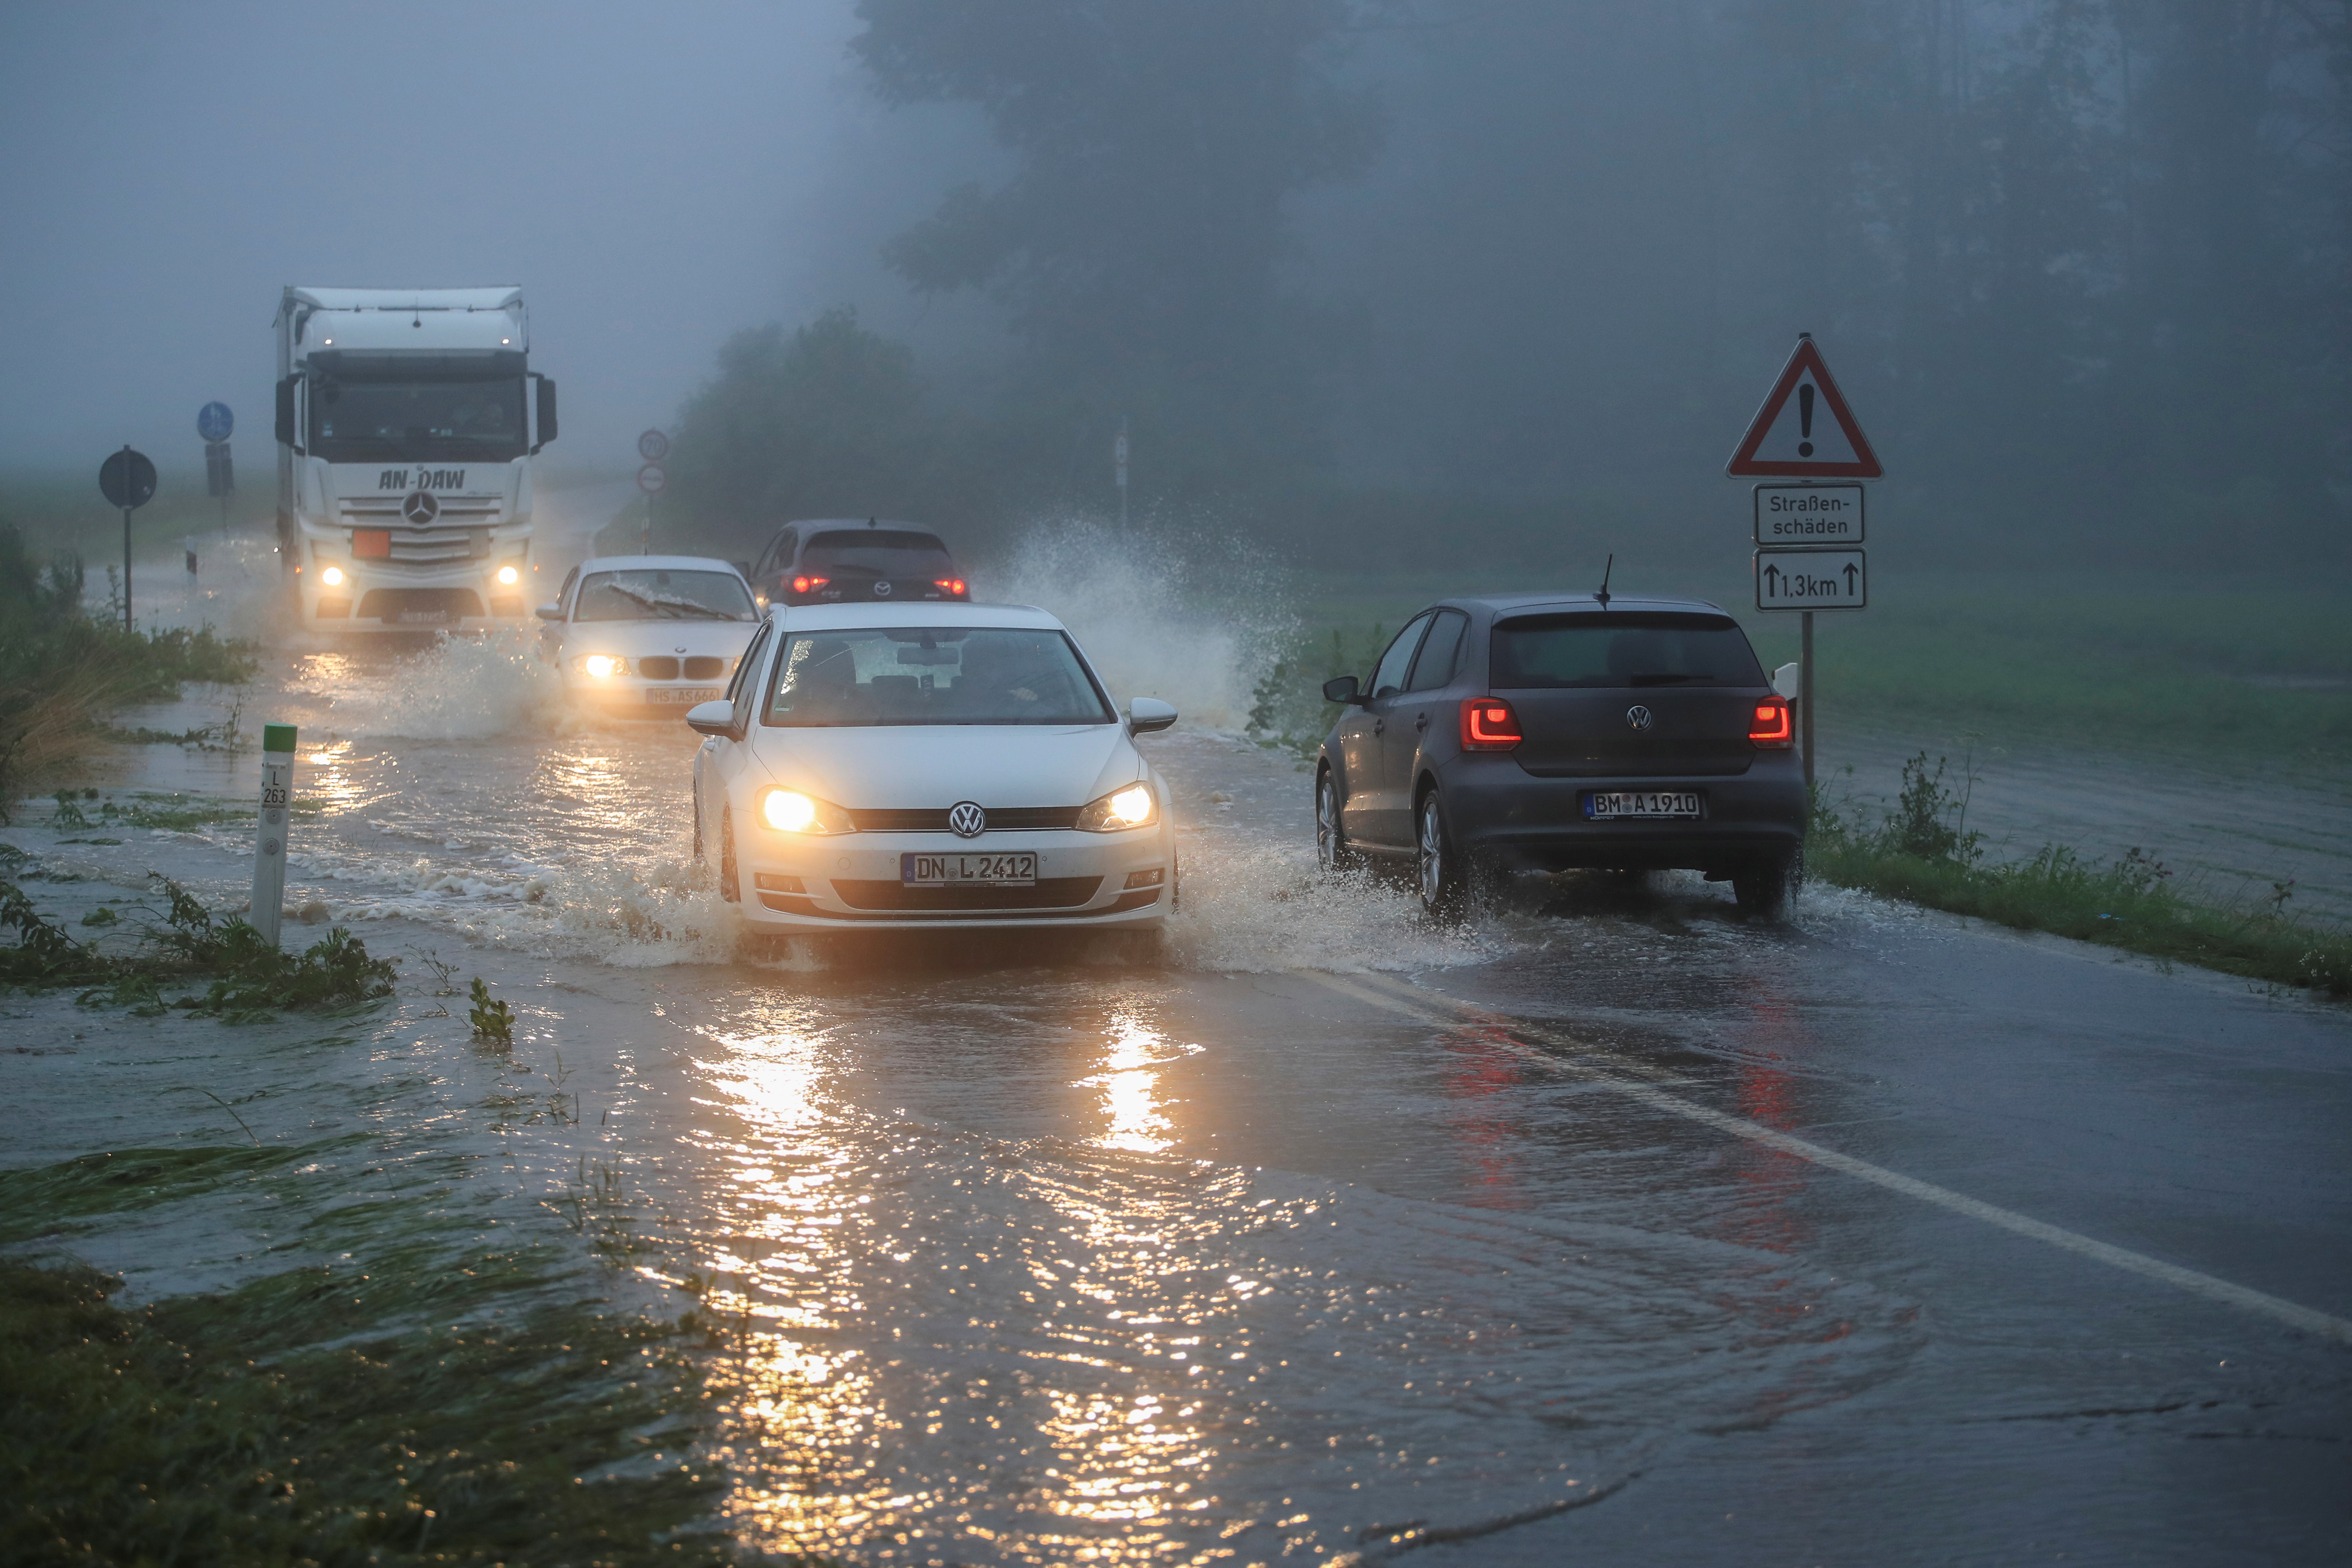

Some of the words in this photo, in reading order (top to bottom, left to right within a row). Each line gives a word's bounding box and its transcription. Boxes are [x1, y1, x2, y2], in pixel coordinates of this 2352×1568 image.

[1770, 495, 1850, 512] Straßen-
[1773, 518, 1848, 534] schäden
[654, 691, 670, 702] HS
[273, 771, 279, 786] L
[264, 788, 286, 804] 263
[1595, 795, 1621, 813] BM
[1635, 795, 1646, 812] A
[1650, 795, 1696, 812] 1910
[917, 858, 945, 878] DN
[960, 857, 974, 878] L
[979, 857, 1032, 878] 2412
